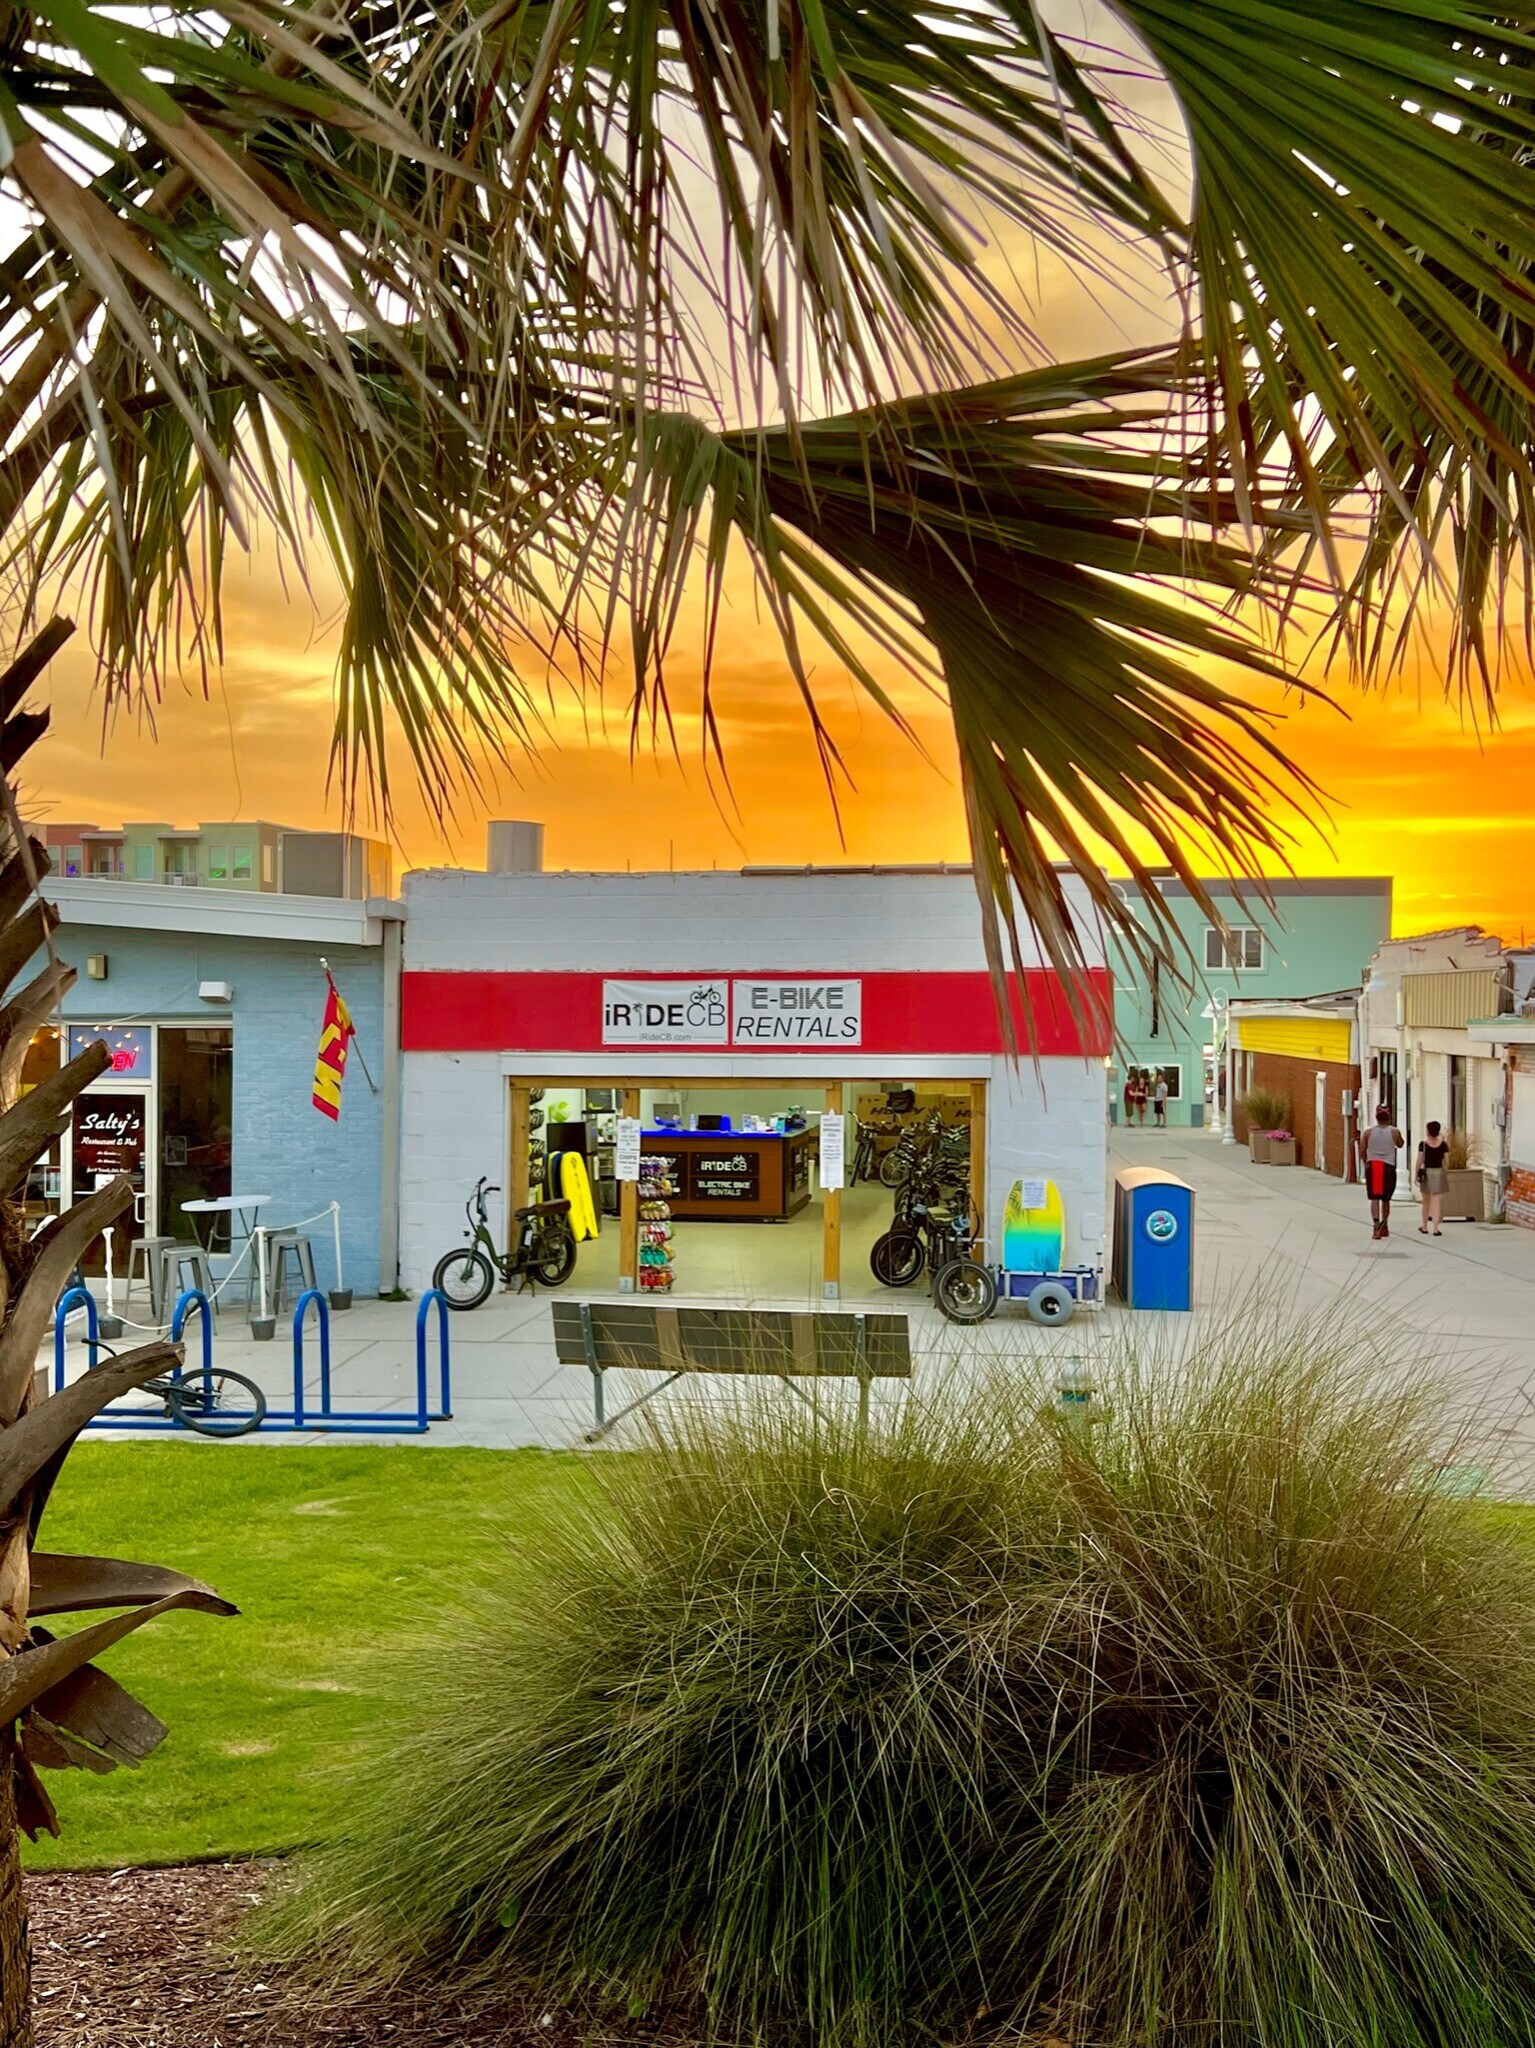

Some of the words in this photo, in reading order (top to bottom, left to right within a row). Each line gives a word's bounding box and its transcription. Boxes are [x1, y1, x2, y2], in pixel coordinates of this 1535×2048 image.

[751, 987, 843, 1009] E-BIKE
[639, 1033, 691, 1041] iRideCB.com
[736, 1016, 858, 1037] RENTALS
[79, 1112, 140, 1136] Salty's
[707, 1188, 741, 1196] RENTALS
